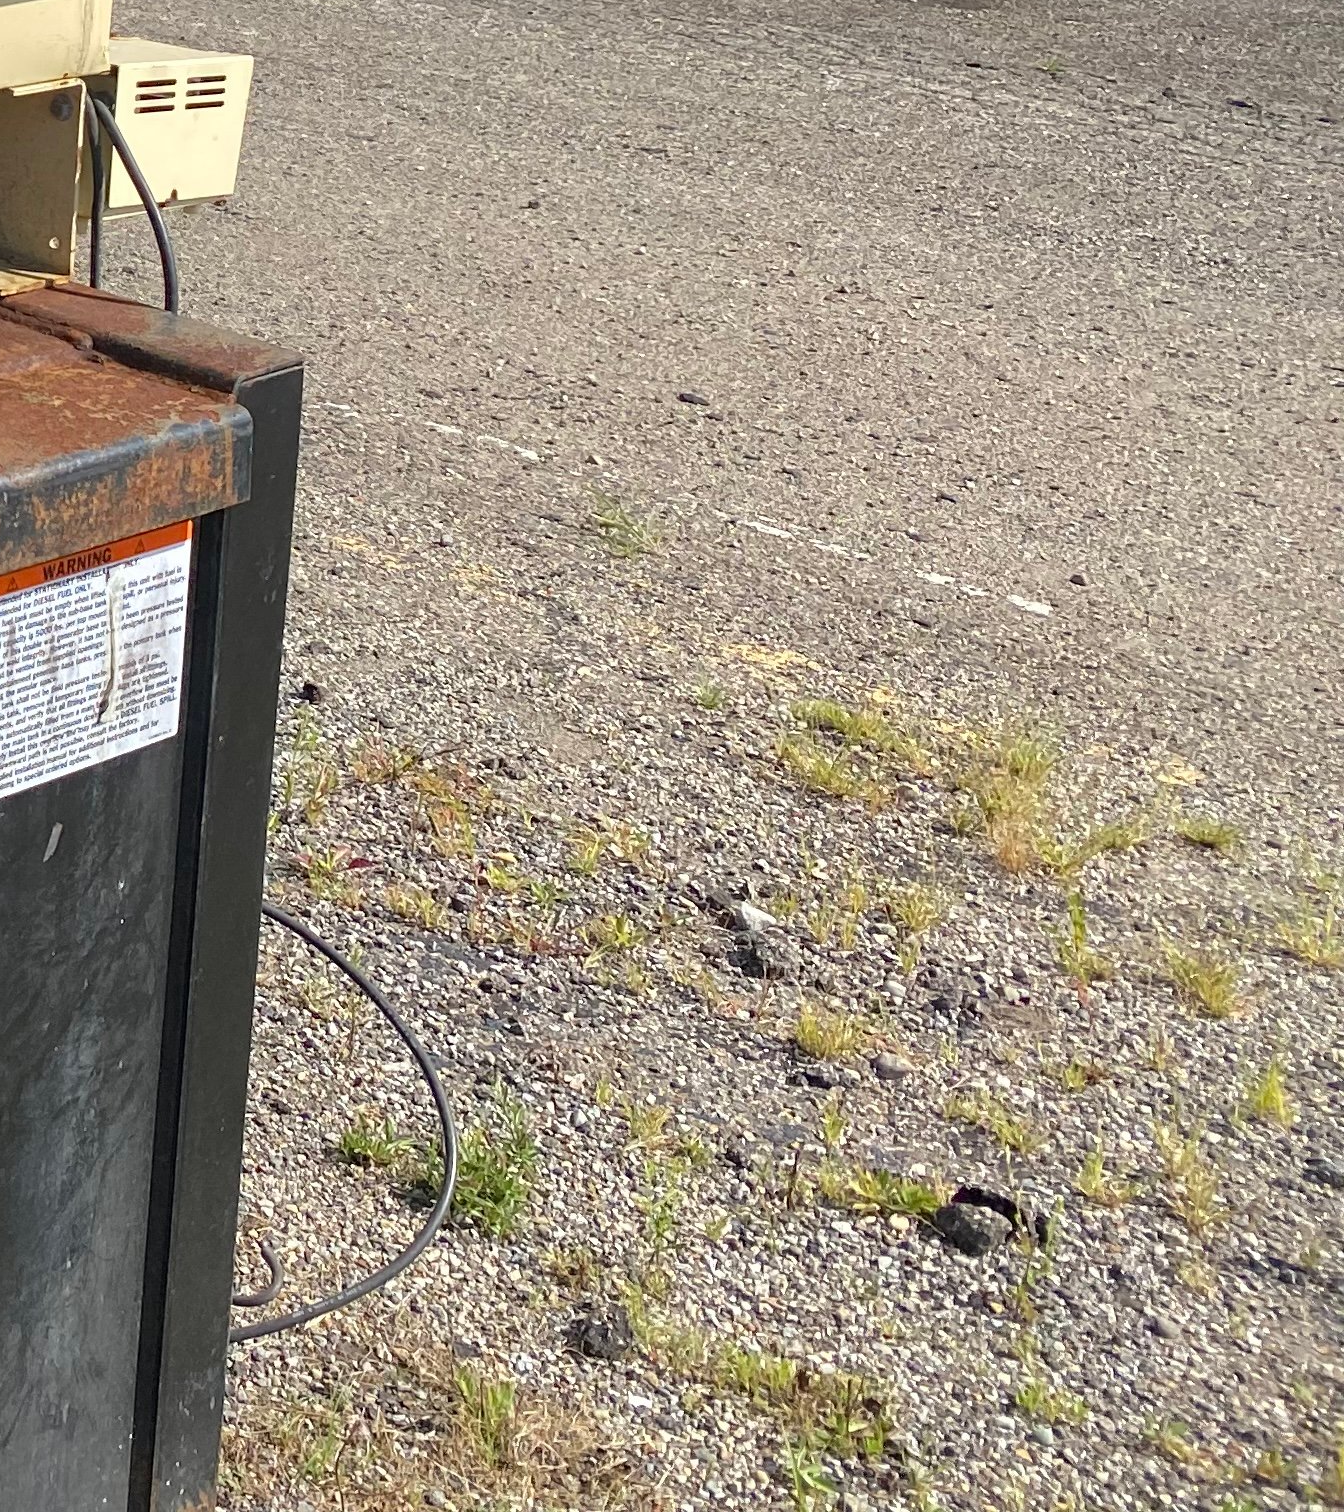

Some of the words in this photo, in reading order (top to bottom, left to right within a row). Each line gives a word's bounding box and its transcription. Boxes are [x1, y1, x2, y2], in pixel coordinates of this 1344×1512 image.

[43, 548, 112, 580] WARNING
[23, 602, 31, 610] for
[34, 594, 55, 606] DIESEL
[57, 589, 73, 599] FUEL
